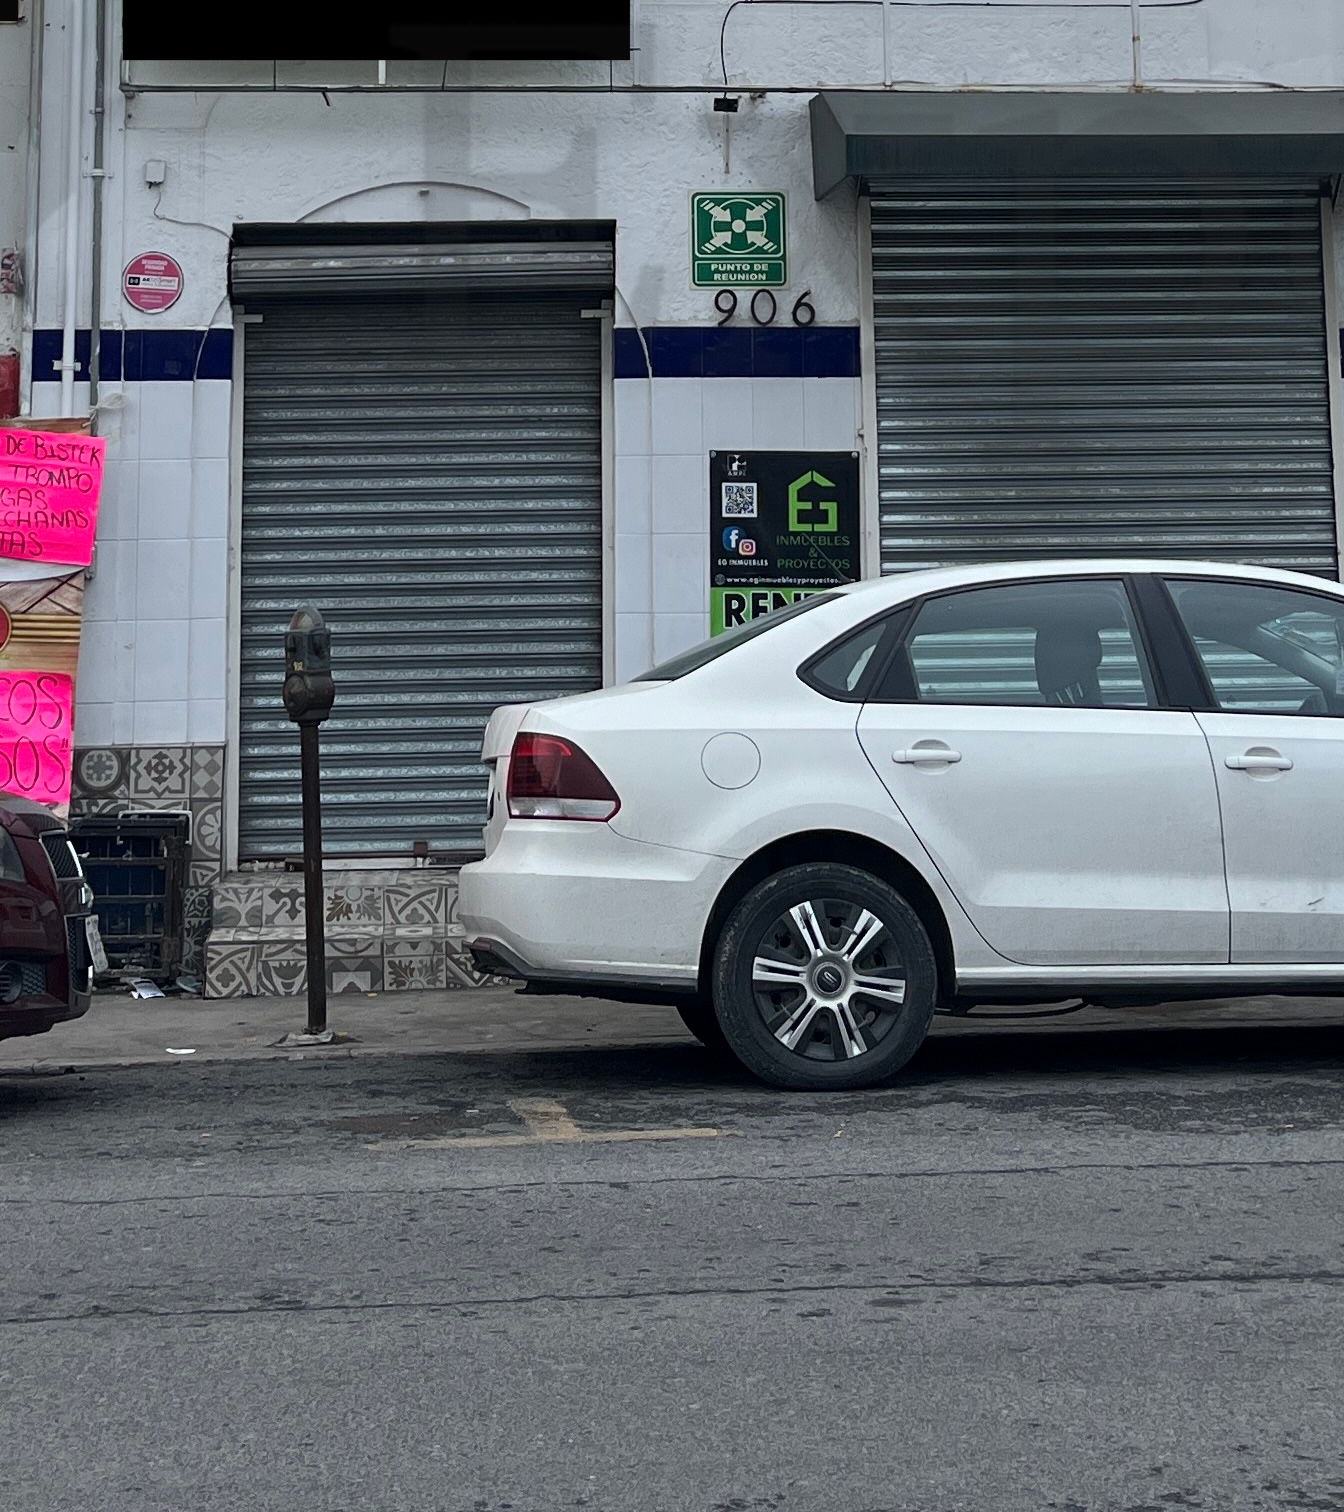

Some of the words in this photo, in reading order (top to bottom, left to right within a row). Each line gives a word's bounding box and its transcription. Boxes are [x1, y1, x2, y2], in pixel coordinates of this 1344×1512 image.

[711, 263, 751, 271] PUNTO
[713, 273, 767, 281] REUNION
[713, 288, 816, 327] 906
[6, 434, 28, 456] DE
[32, 435, 102, 468] BISTEK
[8, 464, 94, 494] TROMPO
